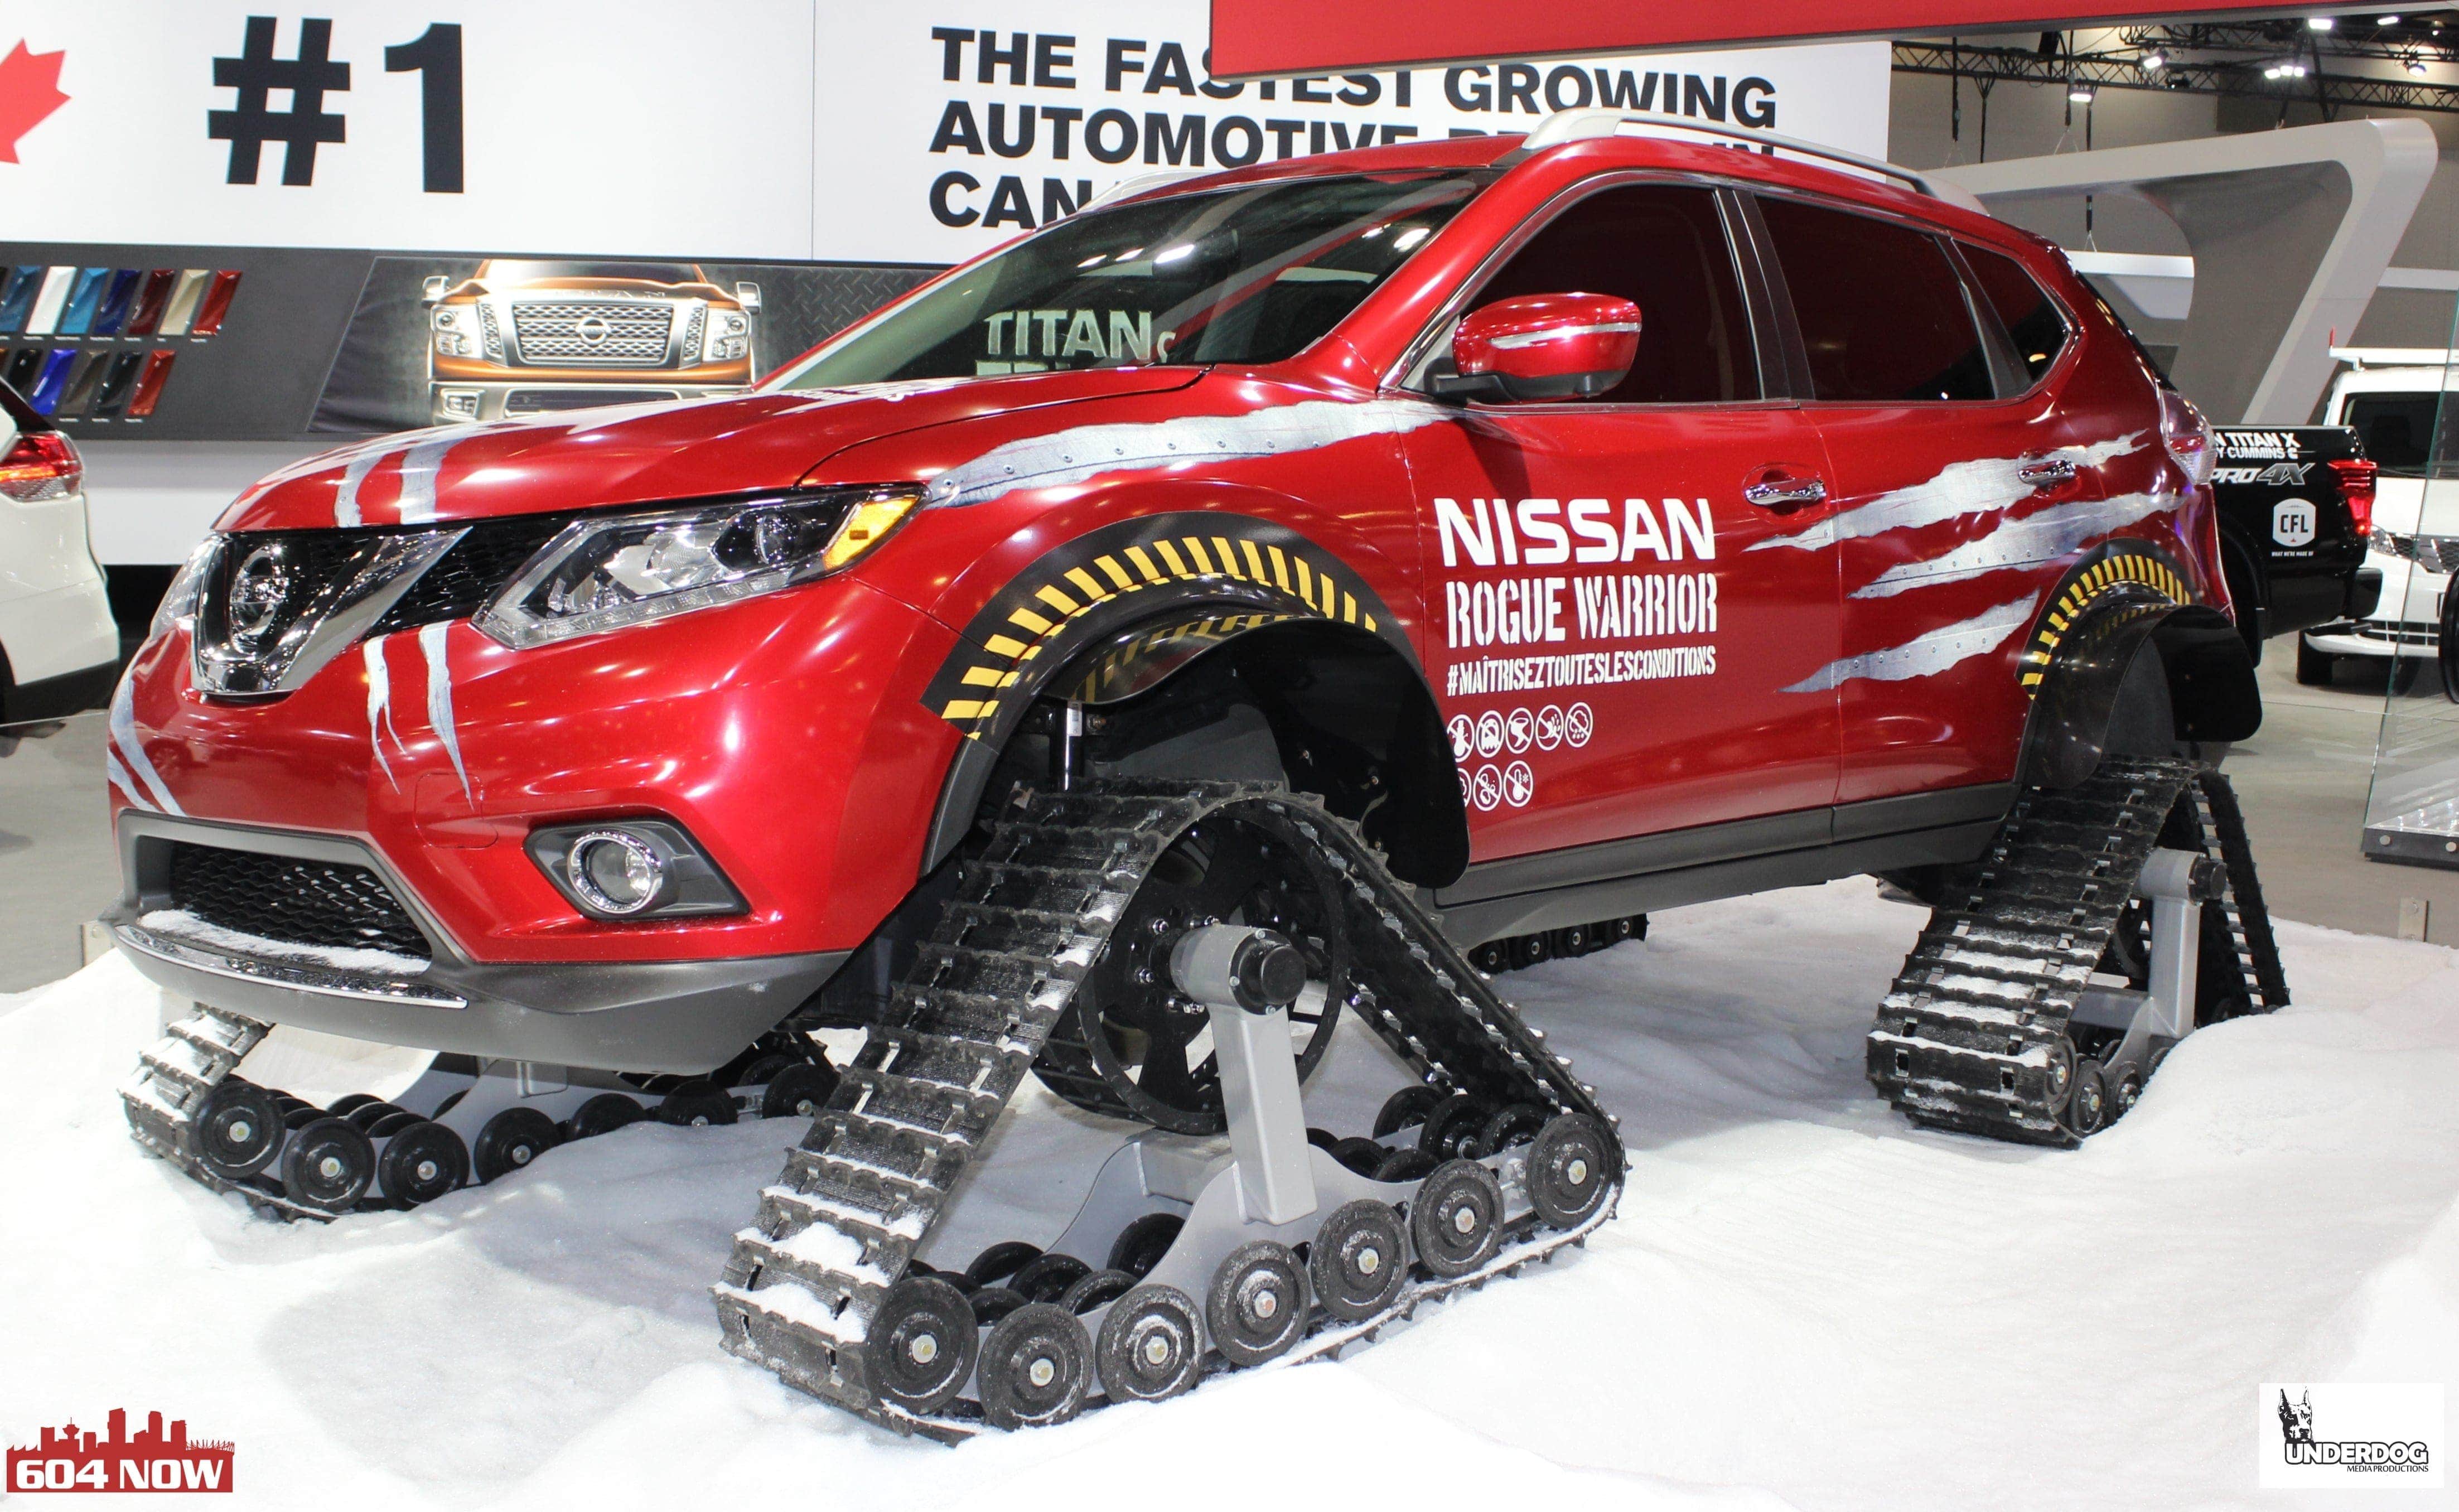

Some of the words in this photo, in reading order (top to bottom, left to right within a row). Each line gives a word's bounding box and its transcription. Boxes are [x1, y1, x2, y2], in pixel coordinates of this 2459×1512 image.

[207, 16, 464, 194] #1
[931, 26, 1076, 89] THE
[1443, 64, 1776, 129] GROWING
[929, 100, 1418, 168] AUTOMOTIV
[929, 171, 1093, 231] CAN
[983, 310, 1152, 361] TITAN
[2225, 432, 2282, 447] TITAN
[2226, 446, 2286, 460] CUMMINS
[1434, 497, 1716, 567] NISSAN
[2280, 514, 2308, 533] CFL
[1446, 577, 1566, 649] ROGUE
[1573, 573, 1717, 640] WARRIOR
[1447, 645, 1716, 697] #MAÎTRISEZTOUTESLESCONDITIONS
